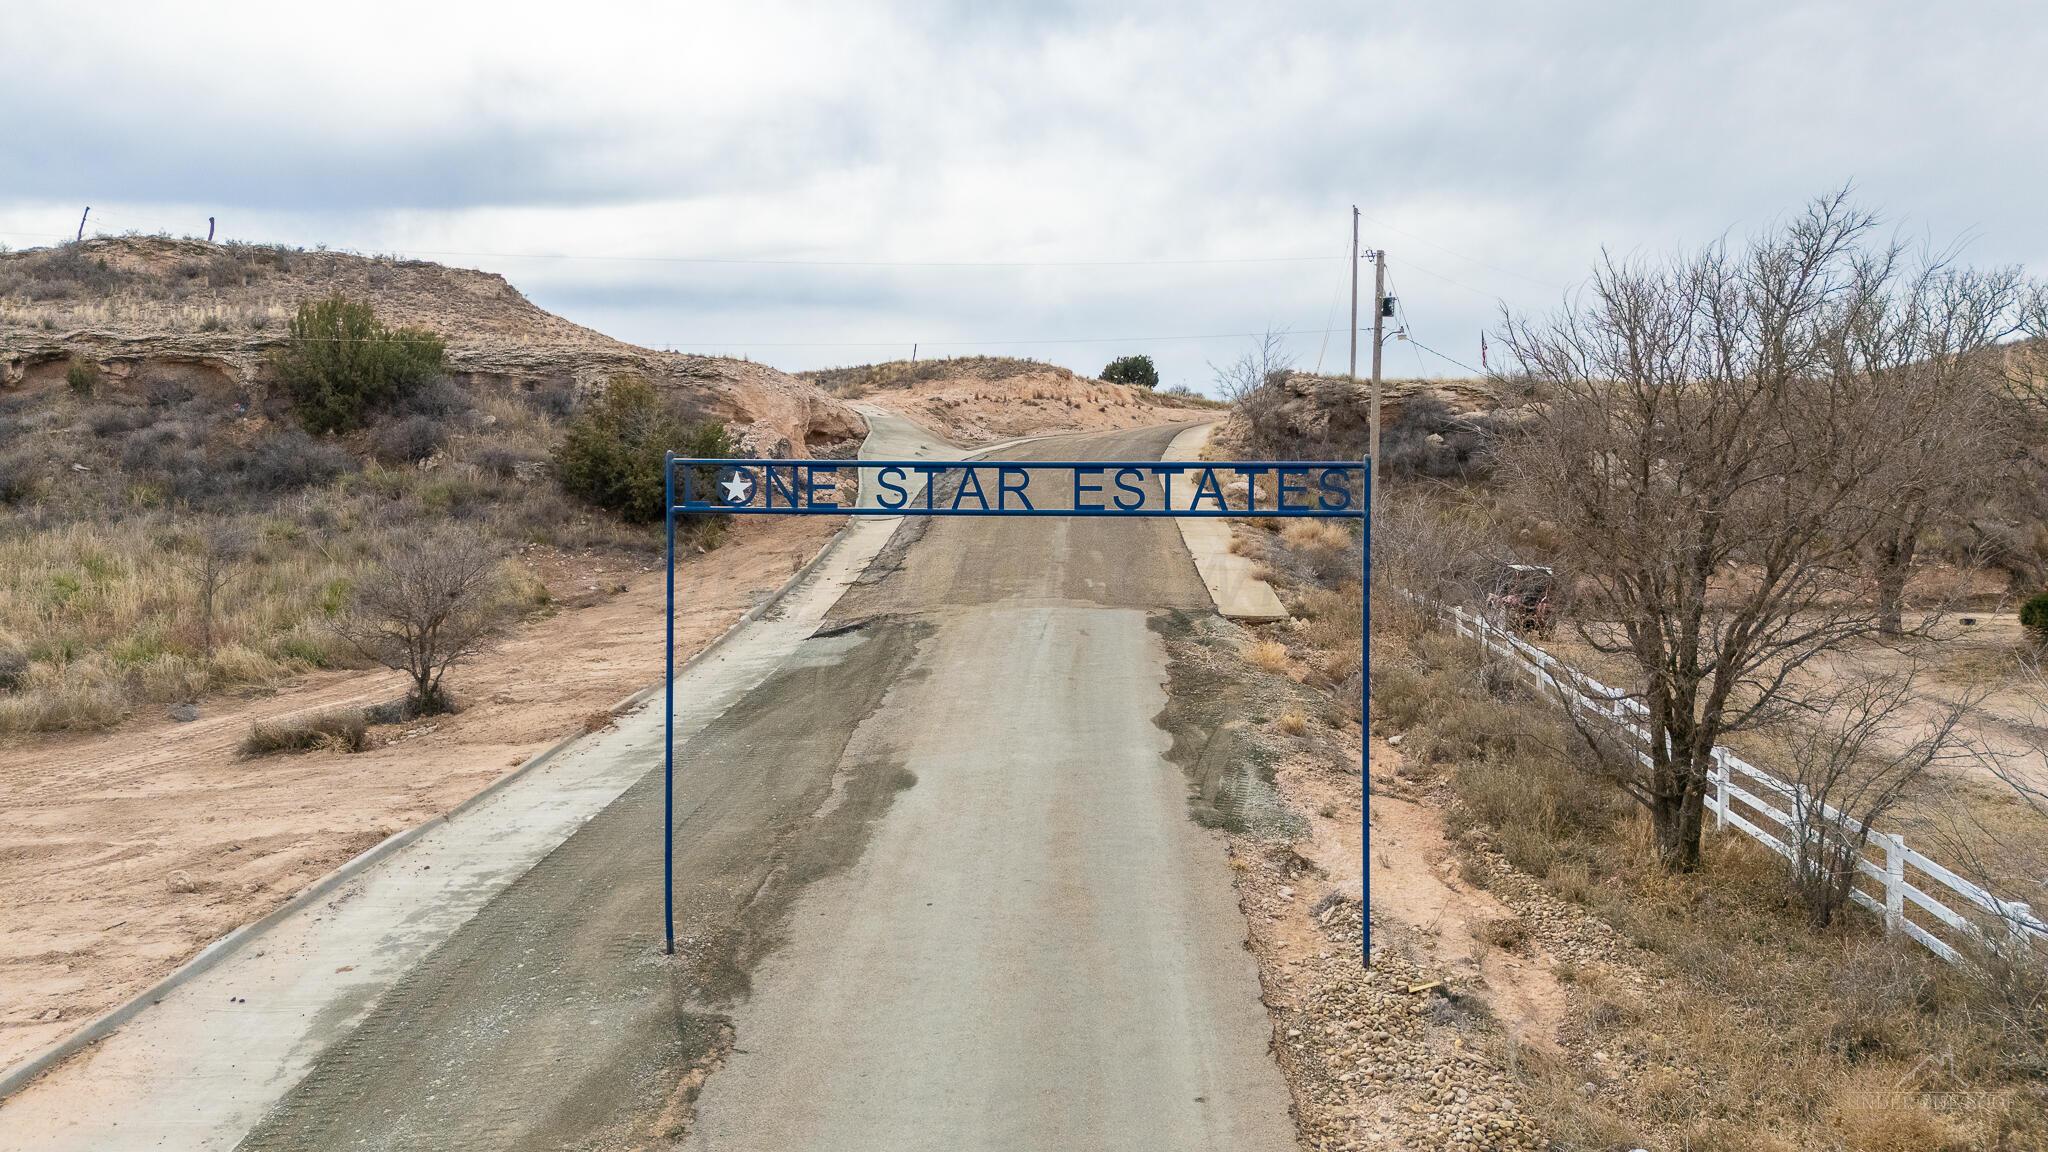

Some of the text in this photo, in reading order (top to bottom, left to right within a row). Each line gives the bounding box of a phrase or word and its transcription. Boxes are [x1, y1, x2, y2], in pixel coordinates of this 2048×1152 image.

[685, 466, 1350, 510] LONE STAR ESTATES
